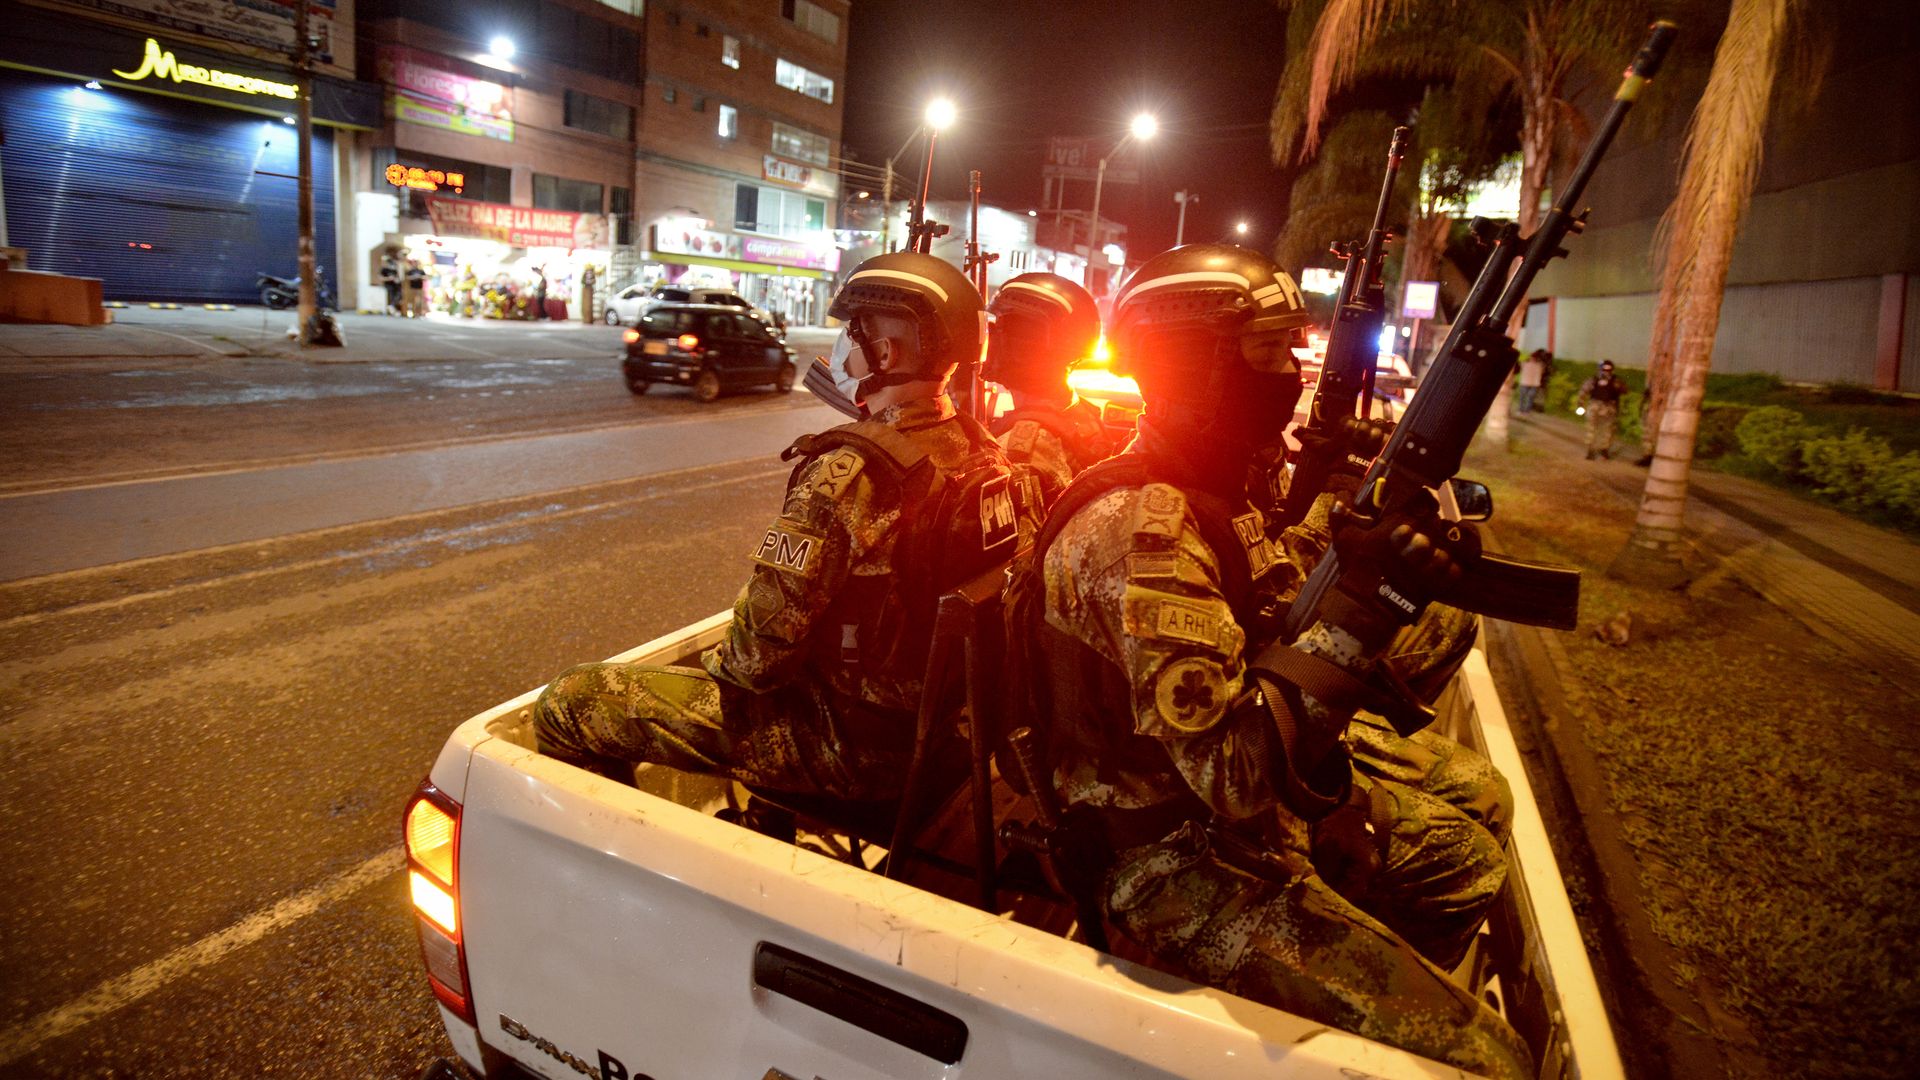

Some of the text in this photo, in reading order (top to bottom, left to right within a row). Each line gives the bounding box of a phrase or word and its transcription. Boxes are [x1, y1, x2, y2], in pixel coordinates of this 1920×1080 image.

[496, 208, 513, 227] DE
[515, 208, 531, 229] LA
[532, 211, 573, 233] MADRE
[1355, 457, 1371, 467] ELIT
[982, 490, 1012, 533] PM
[755, 530, 811, 570] PM
[1388, 591, 1417, 613] ELITE
